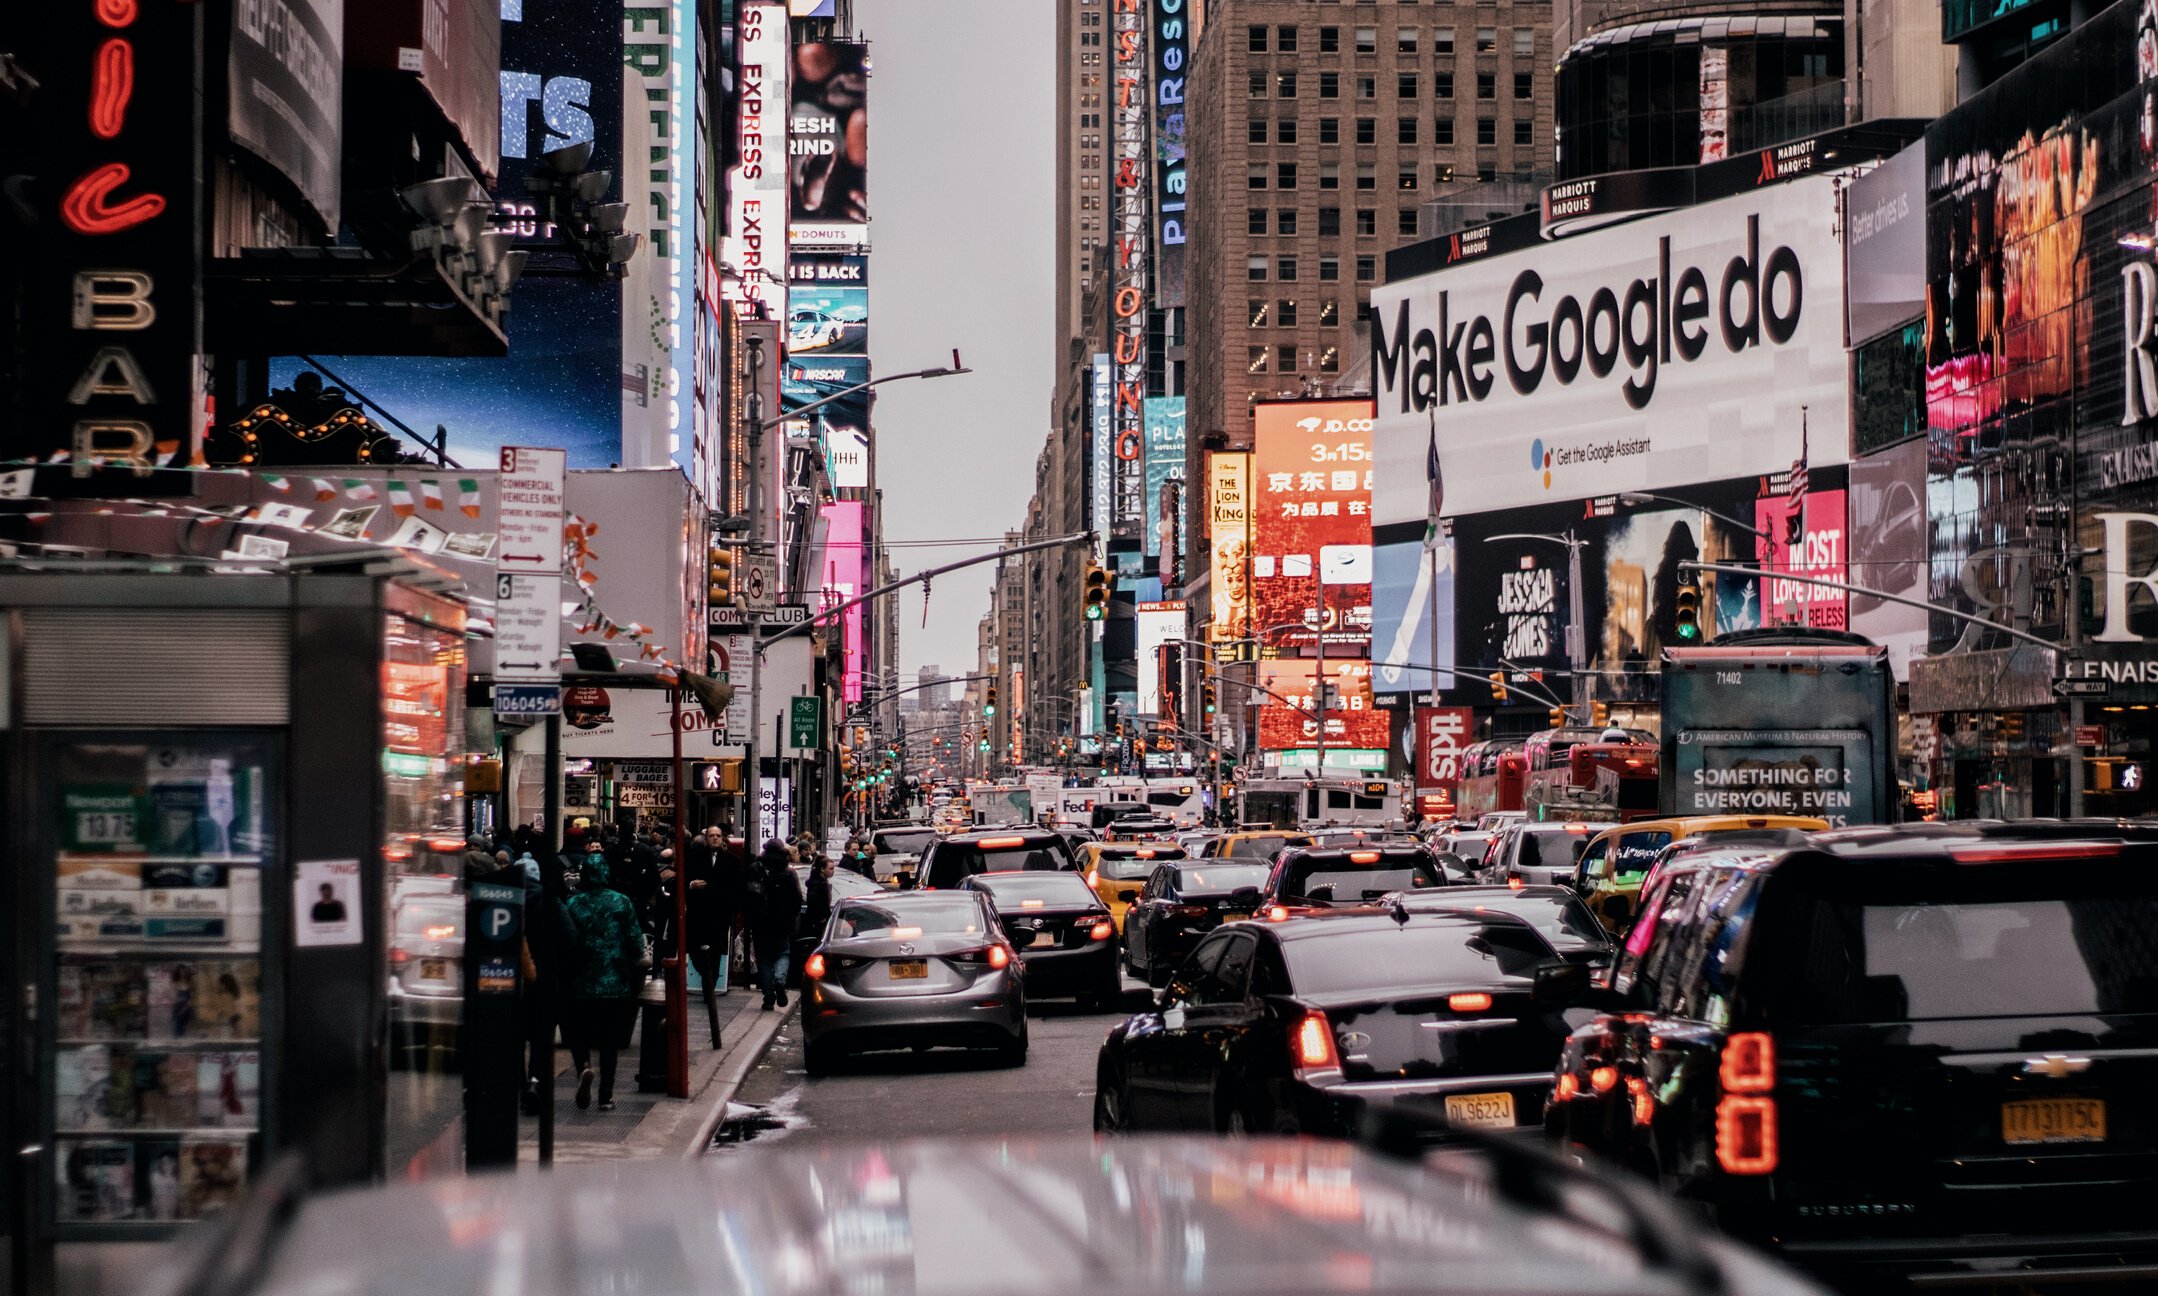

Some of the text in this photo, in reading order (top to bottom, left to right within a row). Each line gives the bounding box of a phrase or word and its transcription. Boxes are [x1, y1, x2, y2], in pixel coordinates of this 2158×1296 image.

[743, 64, 762, 180] EXPRESS
[1778, 140, 1815, 159] MARRIOTT
[1552, 181, 1596, 200] MARRIOTT
[1552, 198, 1590, 216] MARQUIS
[1462, 227, 1490, 242] MARRIOTT
[1852, 211, 1873, 245] Better
[1462, 241, 1487, 255] MARQUIS
[800, 265, 860, 279] IS BACK
[1370, 213, 1802, 413] Make Google do
[1116, 239, 1141, 461] YOUNG
[69, 272, 156, 478] BAR
[804, 369, 847, 381] NASCAR
[1557, 437, 1651, 465] Get the Google Assistant
[502, 449, 514, 472] 3
[502, 480, 554, 491] COMMERCIAL
[1219, 479, 1236, 488] THE
[1770, 474, 1792, 484] MARRIOT
[502, 492, 563, 504] VEHICLES ONLY
[1216, 490, 1240, 503] LION
[1595, 497, 1616, 507] MARRIOTT
[1215, 505, 1243, 523] KING
[1595, 506, 1614, 516] MARQUIS
[1790, 529, 1840, 572] MOST
[499, 576, 509, 598] 6
[1498, 568, 1554, 613] JESSICA
[1503, 614, 1549, 660] JONES
[715, 673, 726, 682] 48
[1716, 672, 1742, 685] 71402
[2059, 682, 2104, 691] ONE WAY
[498, 696, 545, 710] 106045
[795, 723, 814, 731] South
[1695, 731, 1867, 742] AMERICAN MUSEUM NATURAL HISTORY
[1430, 712, 1464, 780] tkts
[621, 766, 668, 774] LUGGAGE
[1694, 768, 1851, 785] SOMETHING FOR
[621, 793, 647, 804] 4 FOR
[1694, 791, 1851, 810] EVERYONE, EVEN
[760, 802, 790, 816] oogle
[1063, 800, 1093, 812] FedE
[762, 827, 774, 838] it.
[492, 908, 511, 935] P
